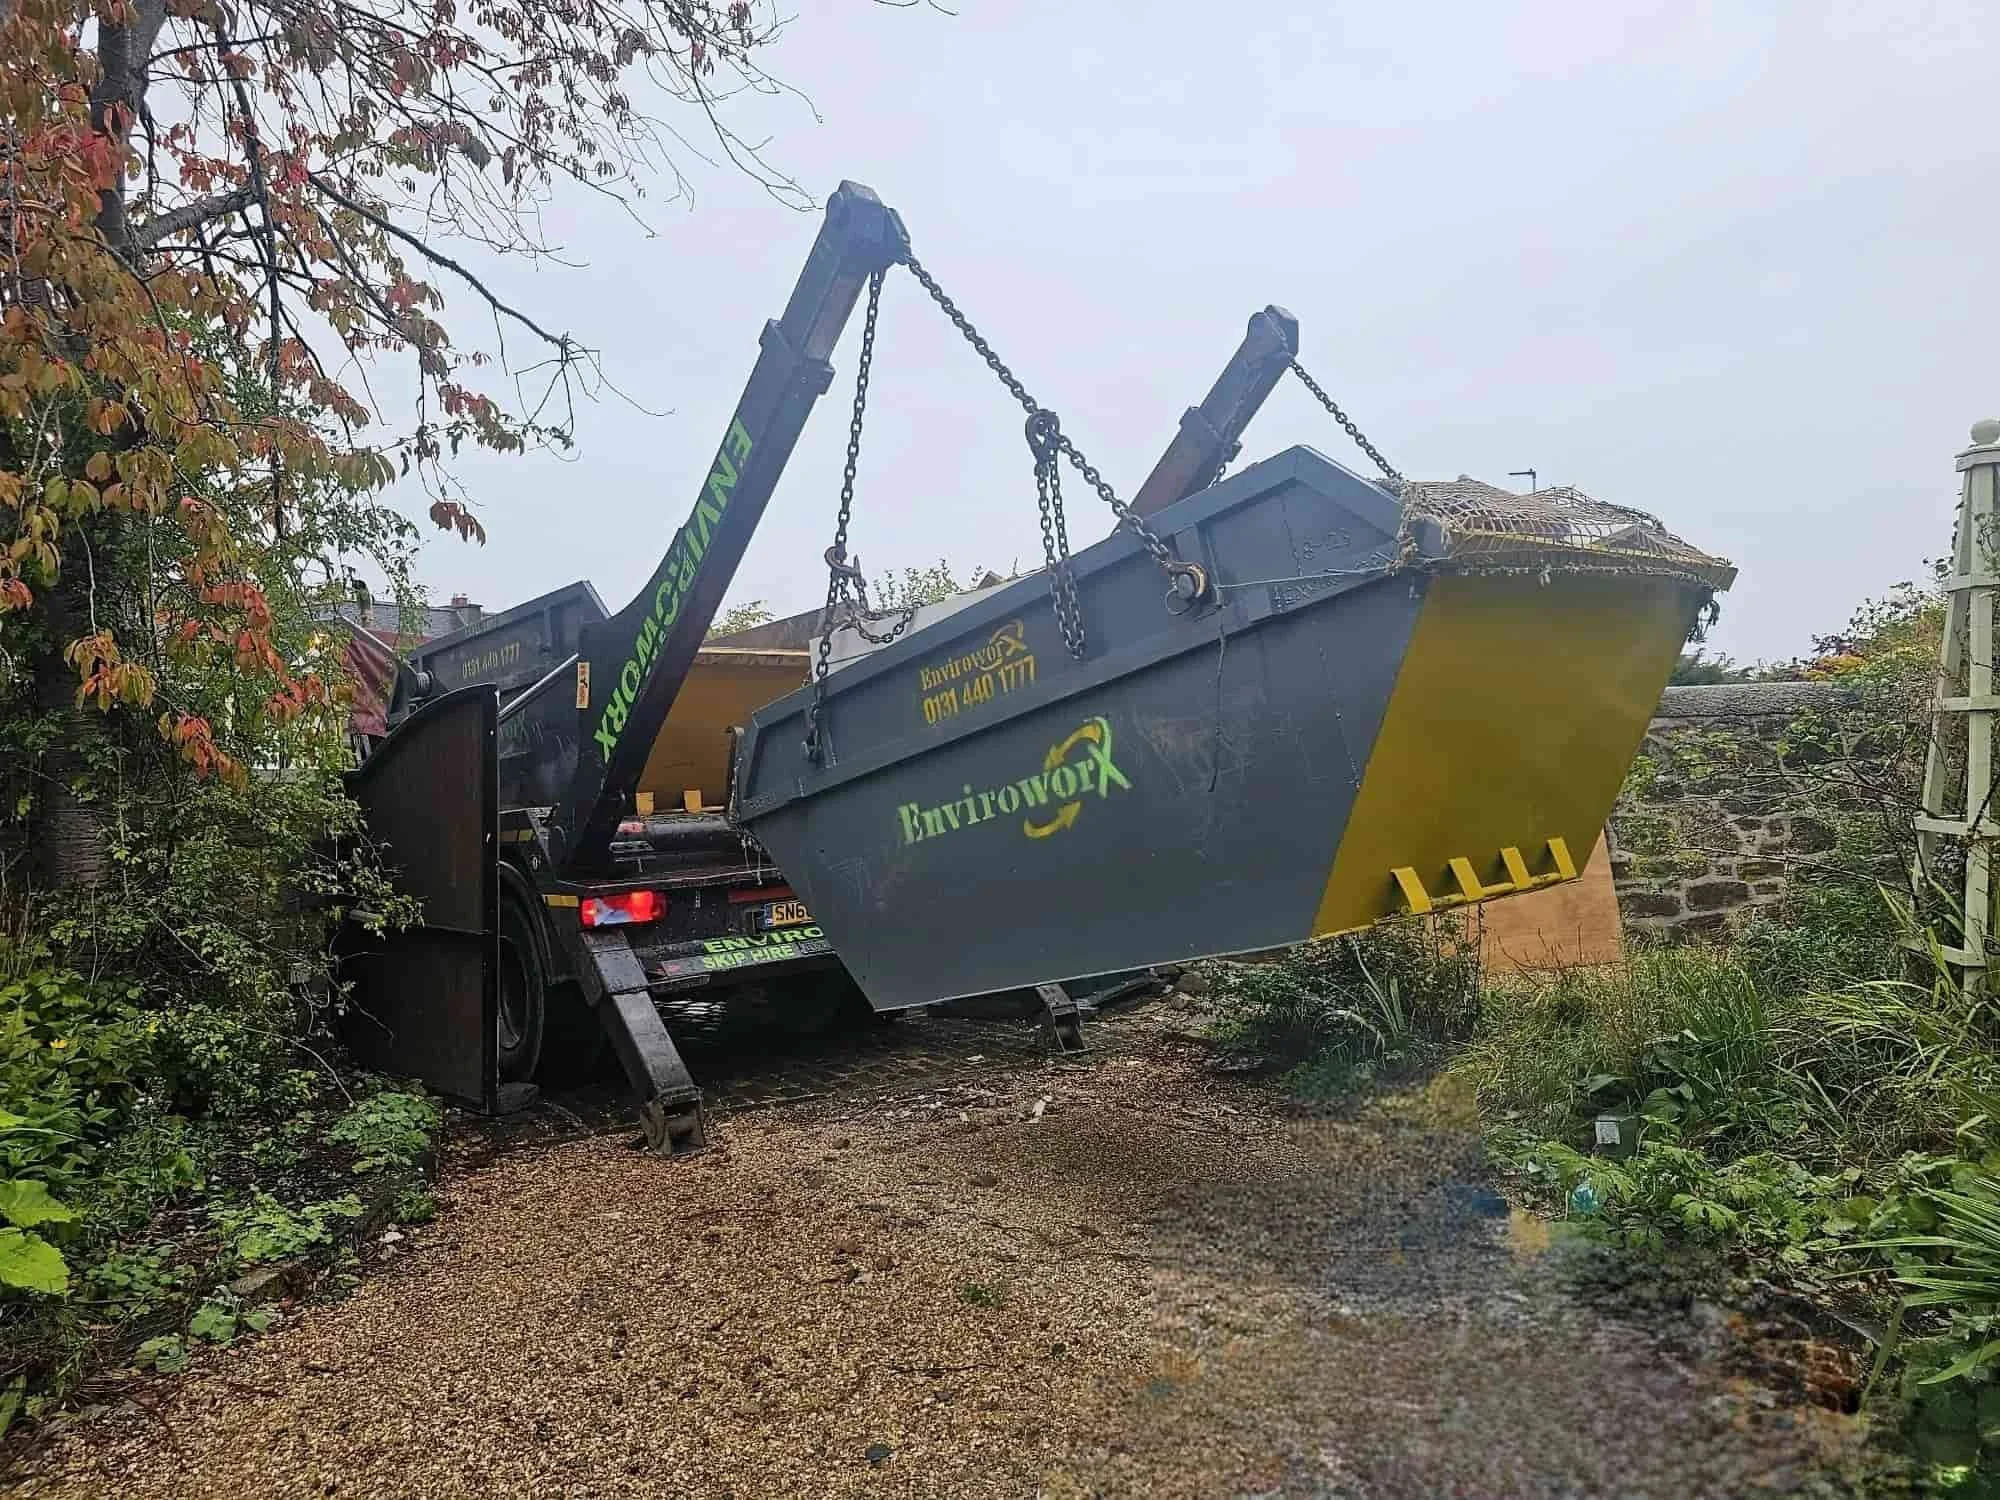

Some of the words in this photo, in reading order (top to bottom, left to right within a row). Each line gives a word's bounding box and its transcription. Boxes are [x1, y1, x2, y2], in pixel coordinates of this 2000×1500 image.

[923, 686, 959, 726] 0131
[963, 673, 996, 707] 440
[998, 655, 1037, 694] 1777
[775, 903, 808, 921] SN6
[703, 927, 824, 953] ENVIRO
[703, 951, 745, 969] SKIP
[751, 943, 794, 962] HIRE
